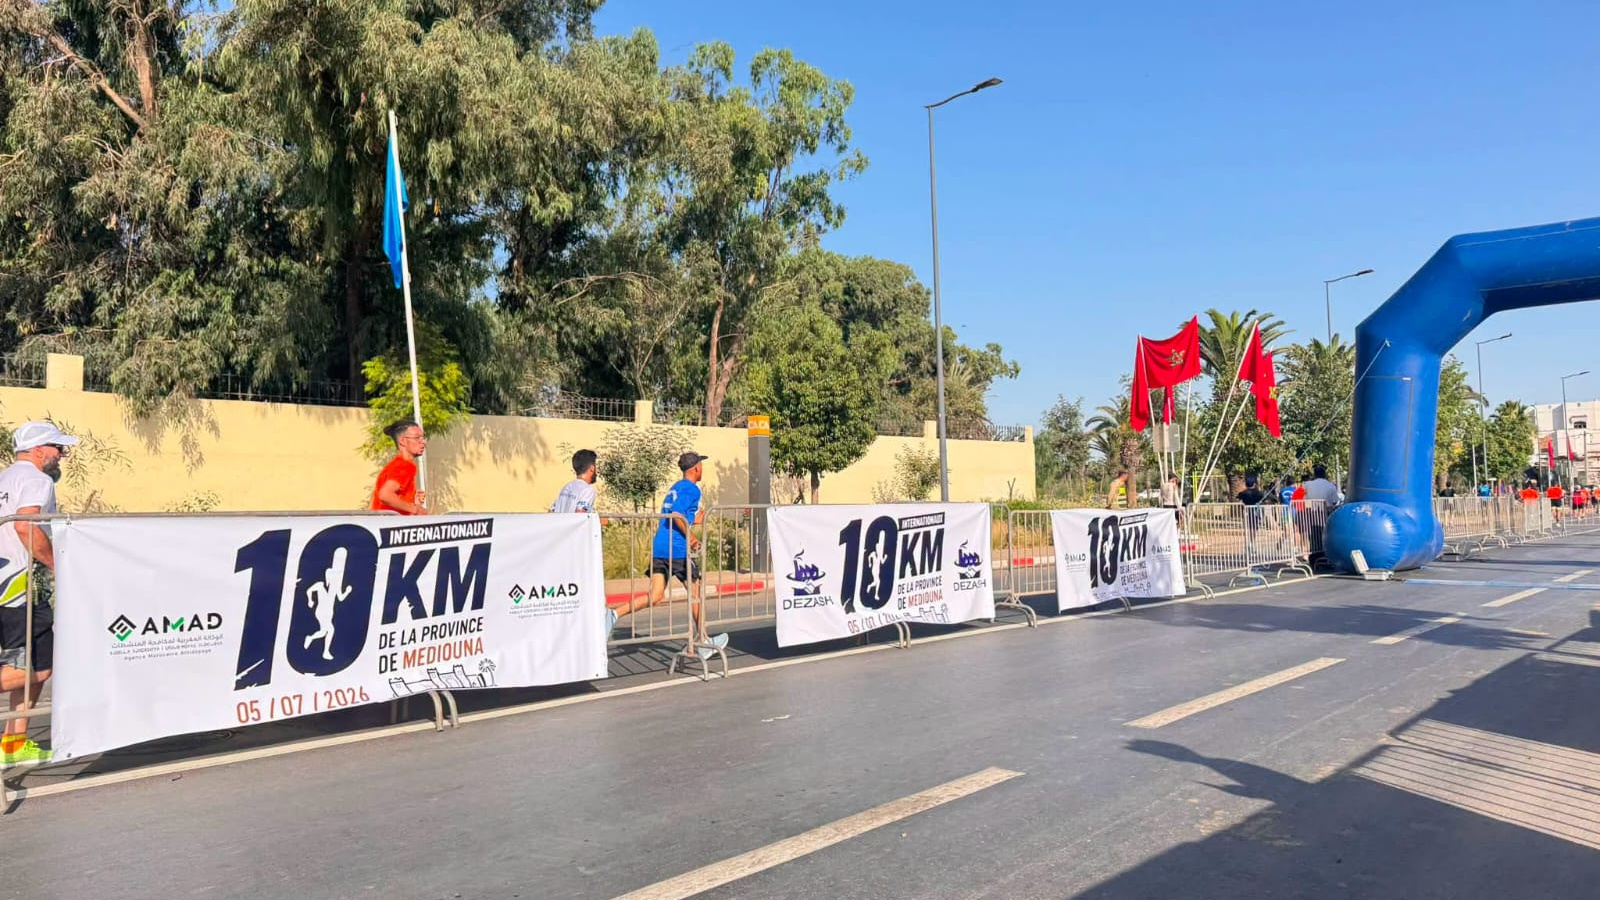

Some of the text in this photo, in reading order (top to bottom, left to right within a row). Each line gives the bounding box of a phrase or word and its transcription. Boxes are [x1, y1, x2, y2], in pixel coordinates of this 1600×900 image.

[389, 521, 489, 546] INTERNATIONAUX
[1088, 515, 1148, 589] 10 KM
[839, 515, 898, 614] 10
[899, 528, 945, 579] KM
[528, 582, 579, 600] AMAD
[897, 575, 942, 595] DE LA PROVINCE
[953, 579, 987, 592] DEZASH
[234, 524, 492, 691] 10 KM
[783, 595, 834, 610] DEZASH
[897, 589, 943, 610] DE MEDIOUNA
[141, 612, 223, 635] AMAD
[379, 616, 484, 650] DE LA PROVINCE
[378, 637, 484, 674] DE MEDIOUNA
